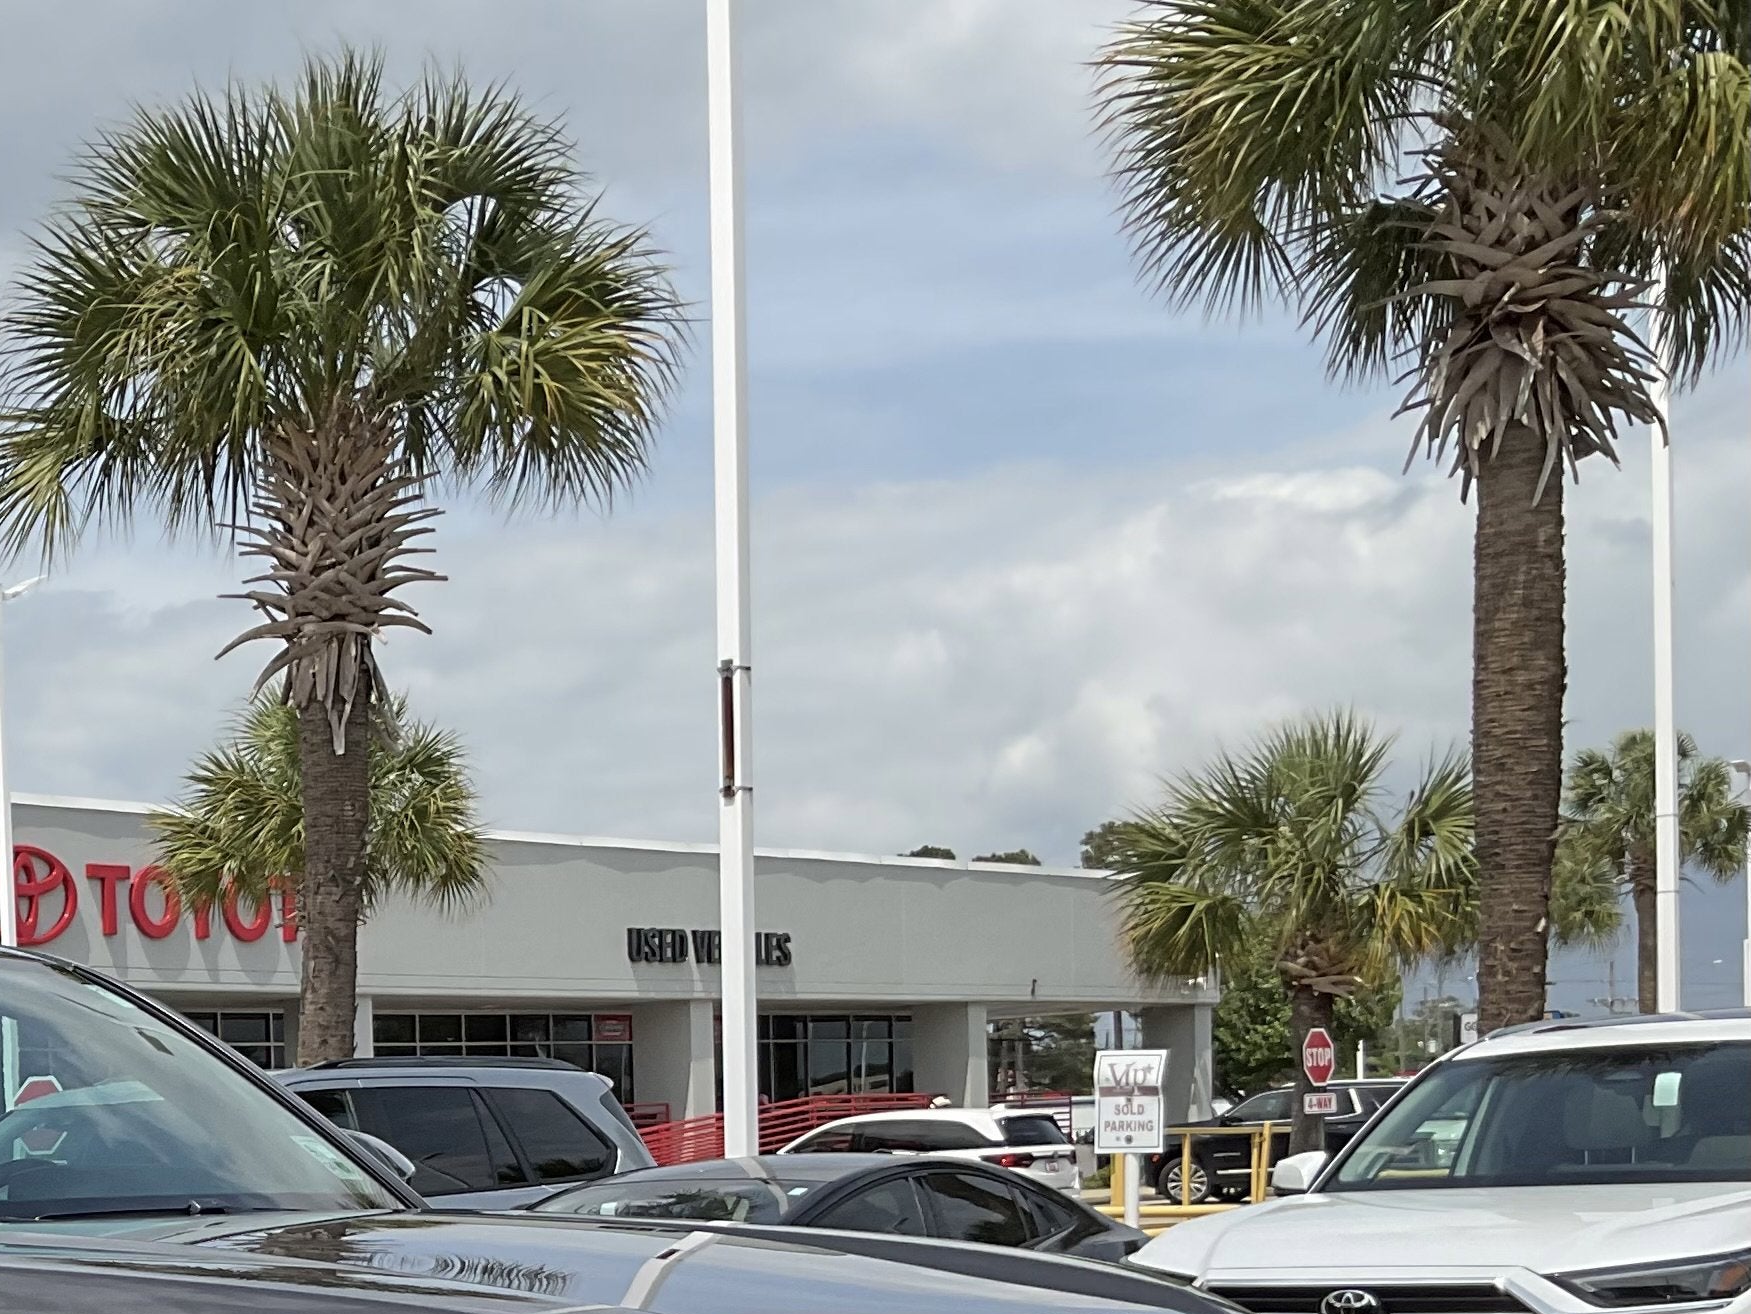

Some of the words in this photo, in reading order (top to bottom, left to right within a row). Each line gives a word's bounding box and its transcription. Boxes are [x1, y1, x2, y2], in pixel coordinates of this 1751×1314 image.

[85, 863, 304, 943] TOOT
[627, 928, 688, 963] USED
[691, 930, 792, 966] VELES
[1306, 1047, 1331, 1067] STOP
[1114, 1104, 1145, 1116] SOLD
[1308, 1096, 1333, 1109] 4-WAY
[1104, 1120, 1154, 1132] PARKING
